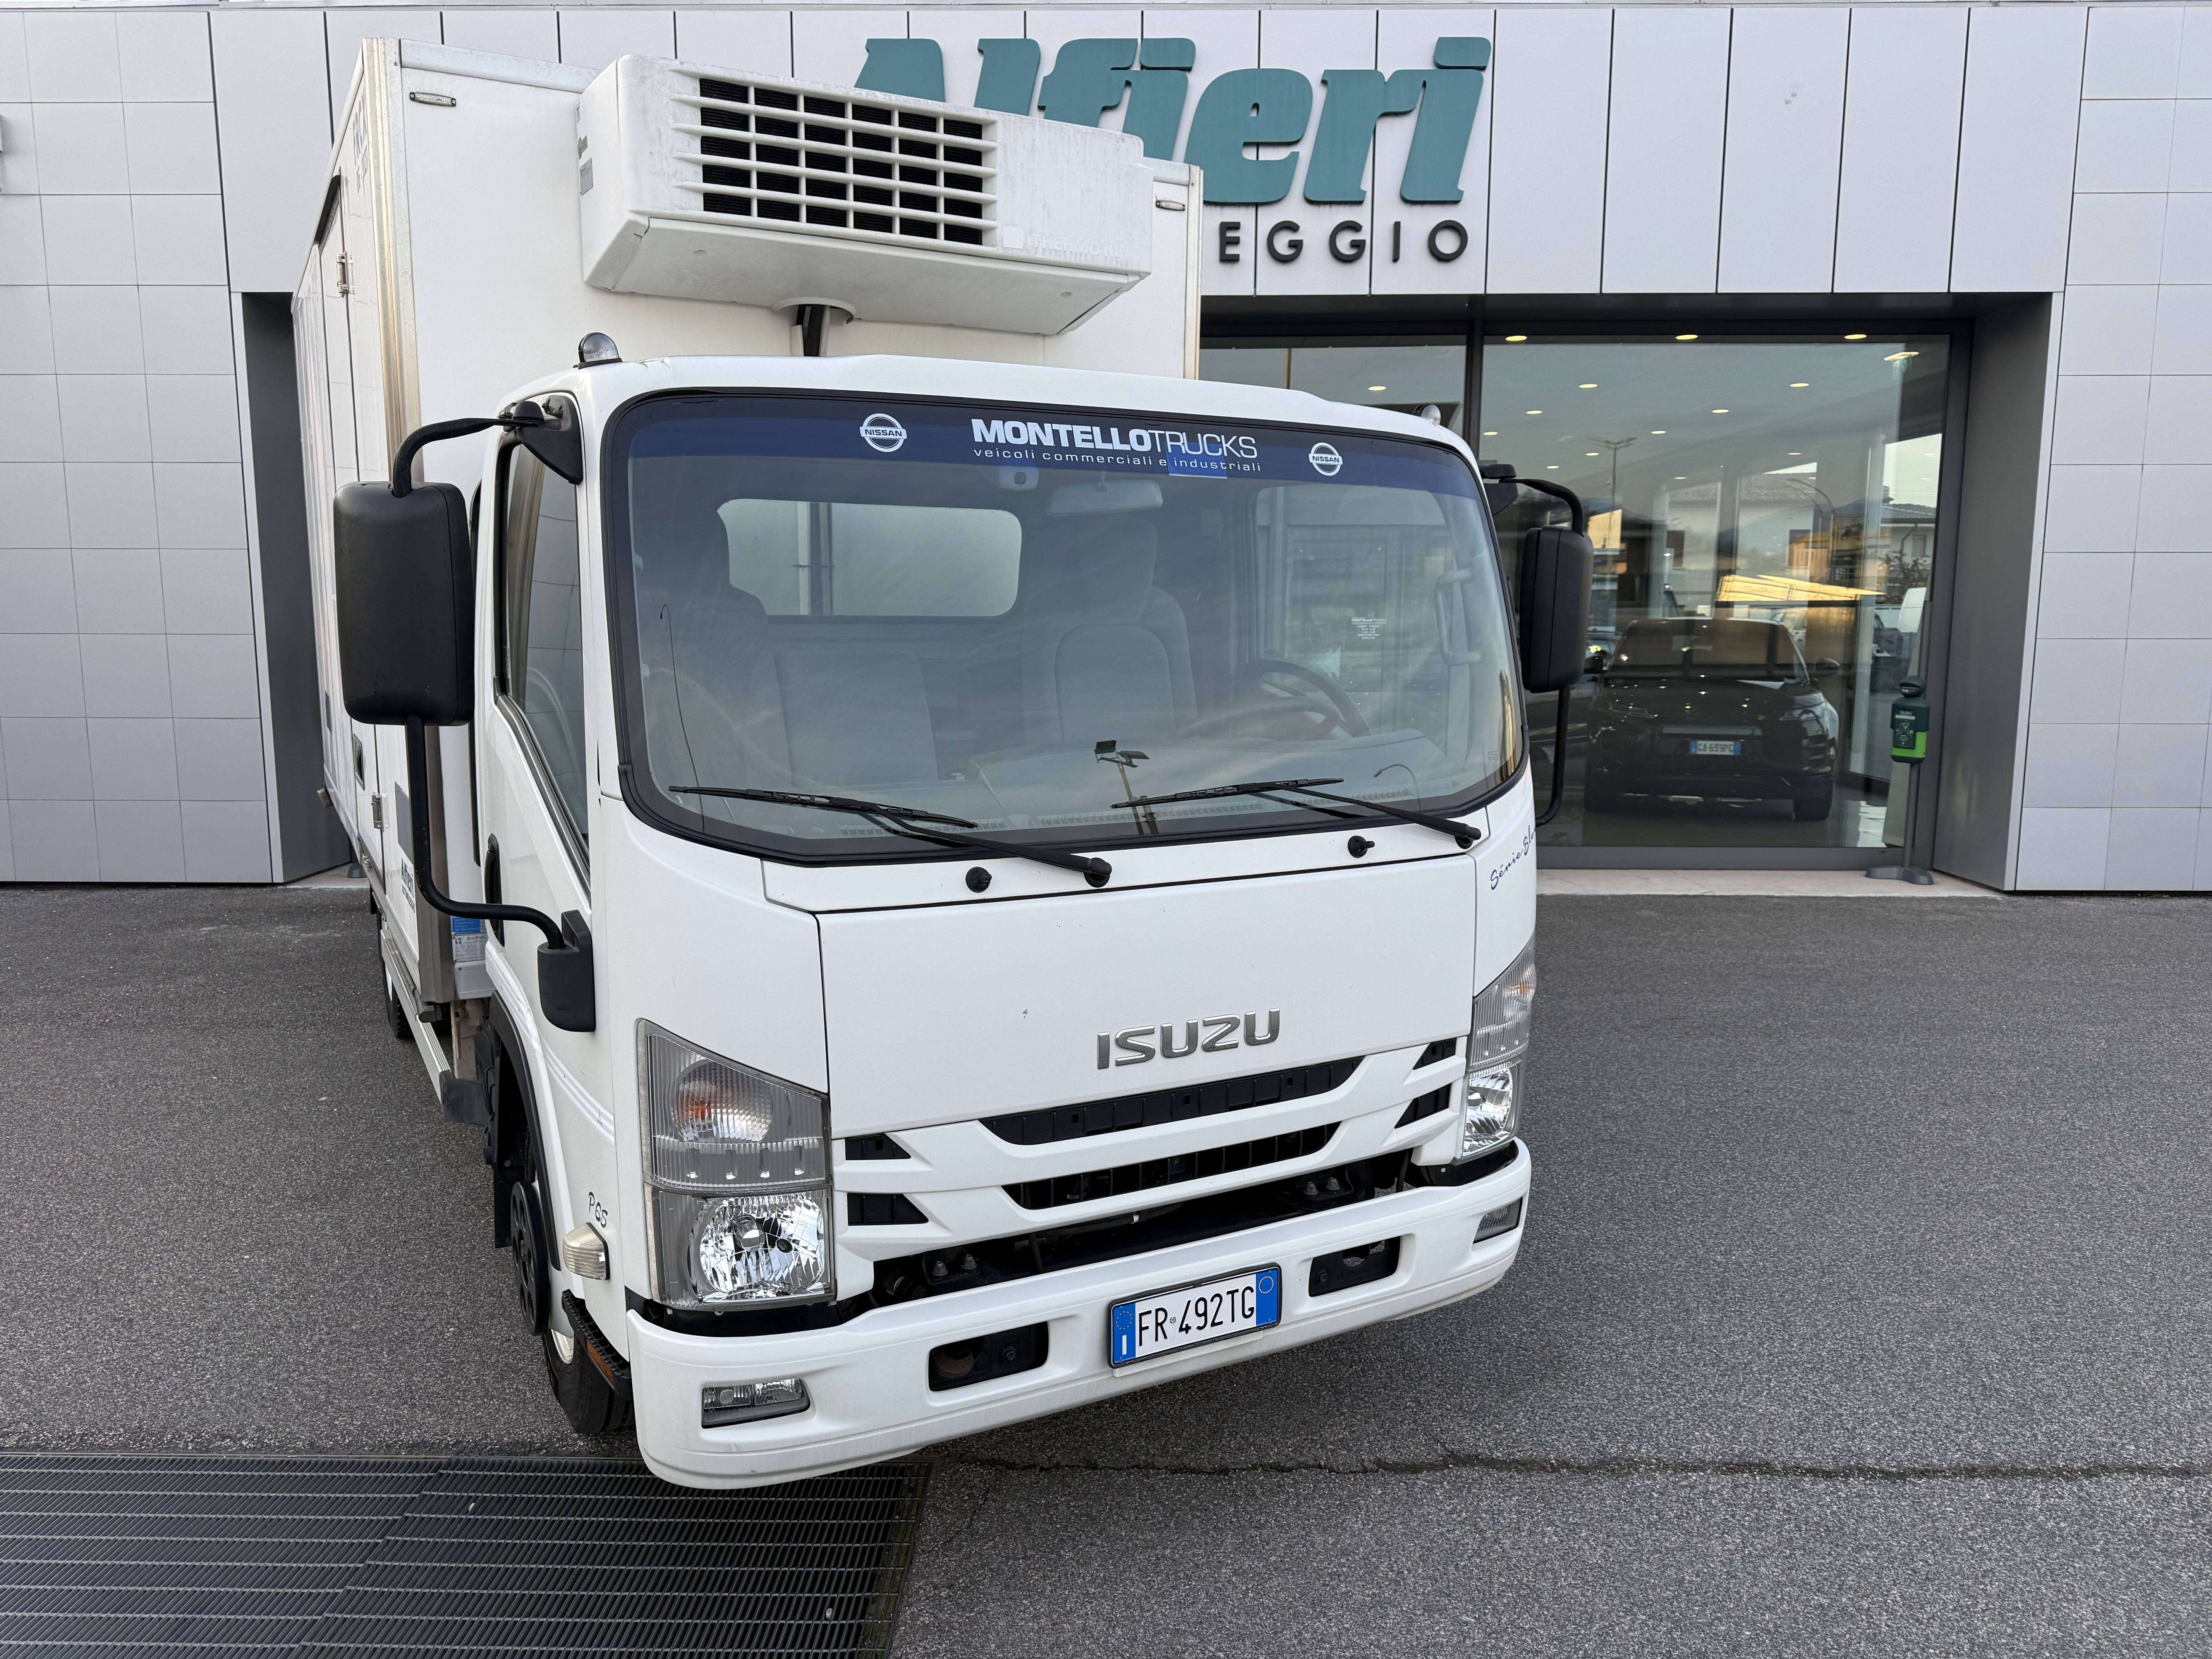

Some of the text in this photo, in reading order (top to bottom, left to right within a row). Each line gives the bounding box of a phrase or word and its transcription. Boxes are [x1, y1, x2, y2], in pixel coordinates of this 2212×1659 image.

[864, 429, 903, 437] NISSAN
[971, 419, 1258, 459] MONTELLOTRUCKS
[973, 448, 1035, 459] veicoli
[1042, 452, 1152, 465] commerciali
[1173, 457, 1261, 472] industriali
[1097, 1008, 1280, 1070] ISUZU
